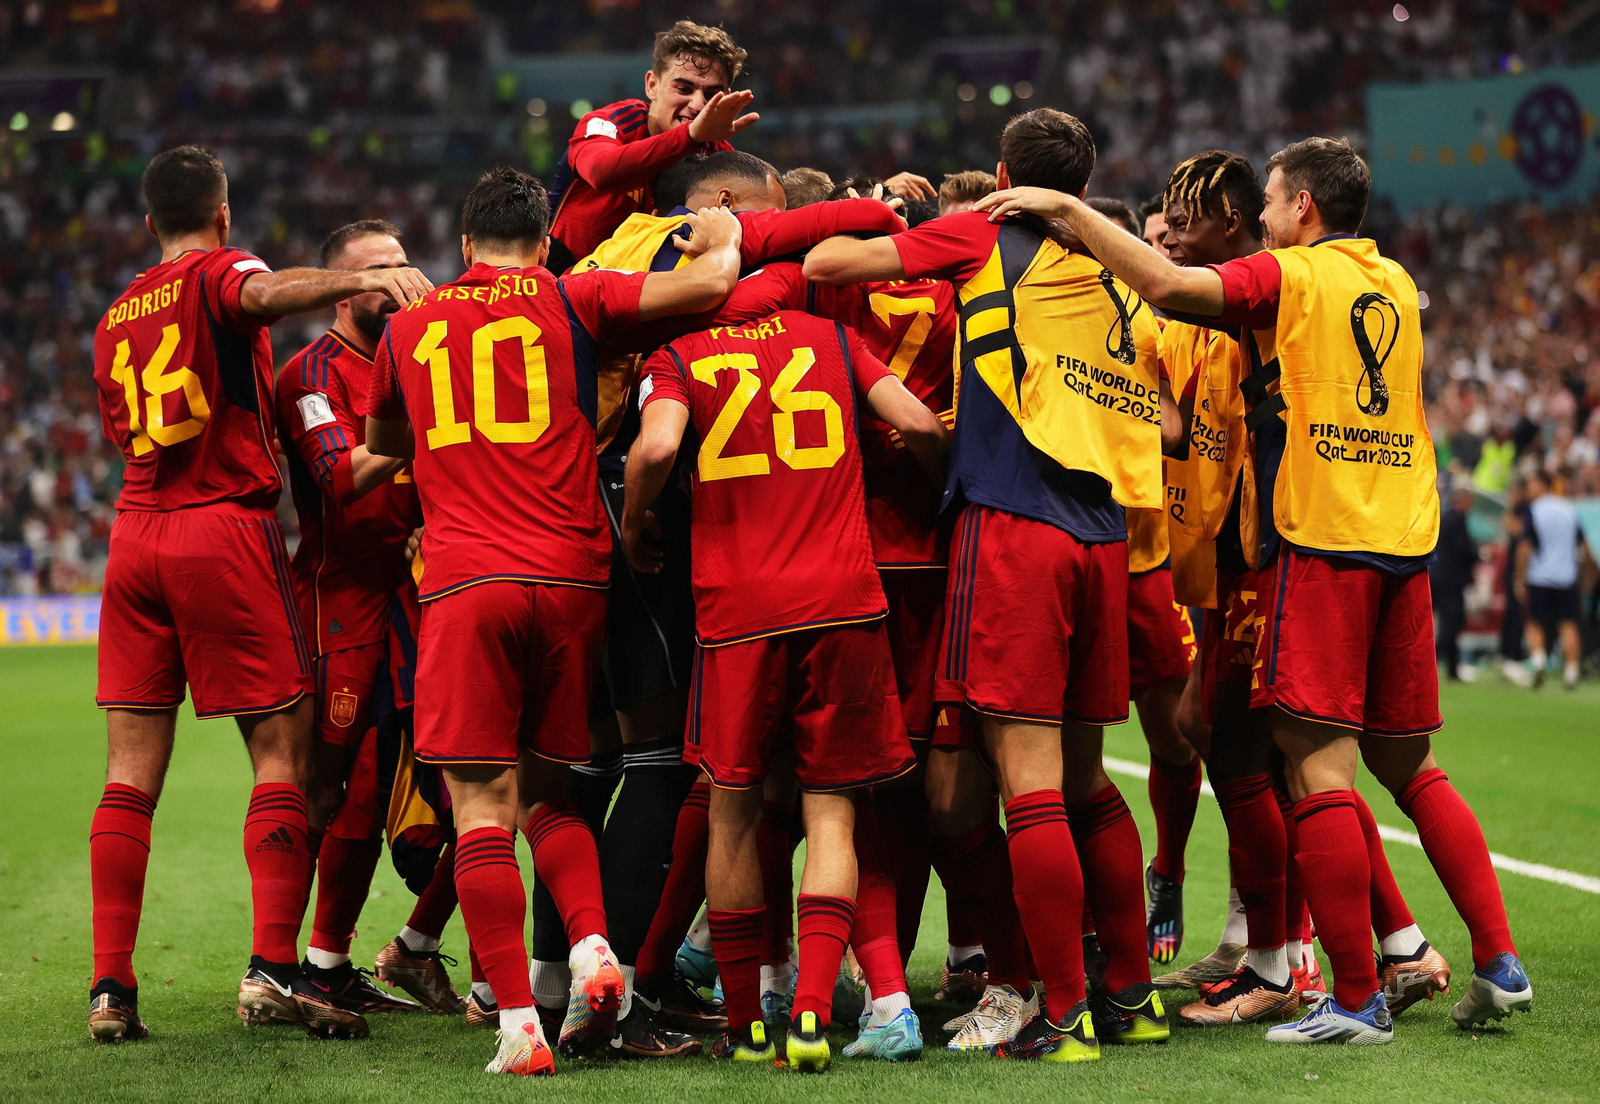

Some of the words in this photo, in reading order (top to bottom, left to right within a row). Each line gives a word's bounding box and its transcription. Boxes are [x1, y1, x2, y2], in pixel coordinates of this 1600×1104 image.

[106, 279, 183, 331] RODRIGO
[437, 275, 539, 306] ASENSIO
[868, 293, 936, 384] 7
[110, 323, 211, 457] 16
[412, 315, 551, 451] 10
[1056, 354, 1088, 377] FIFA
[1090, 365, 1146, 398] WORLD
[690, 347, 846, 482] 26
[1309, 423, 1341, 440] FIFA
[1343, 426, 1390, 446] WORLD
[1391, 433, 1414, 448] CUP
[255, 841, 301, 856] adidas
